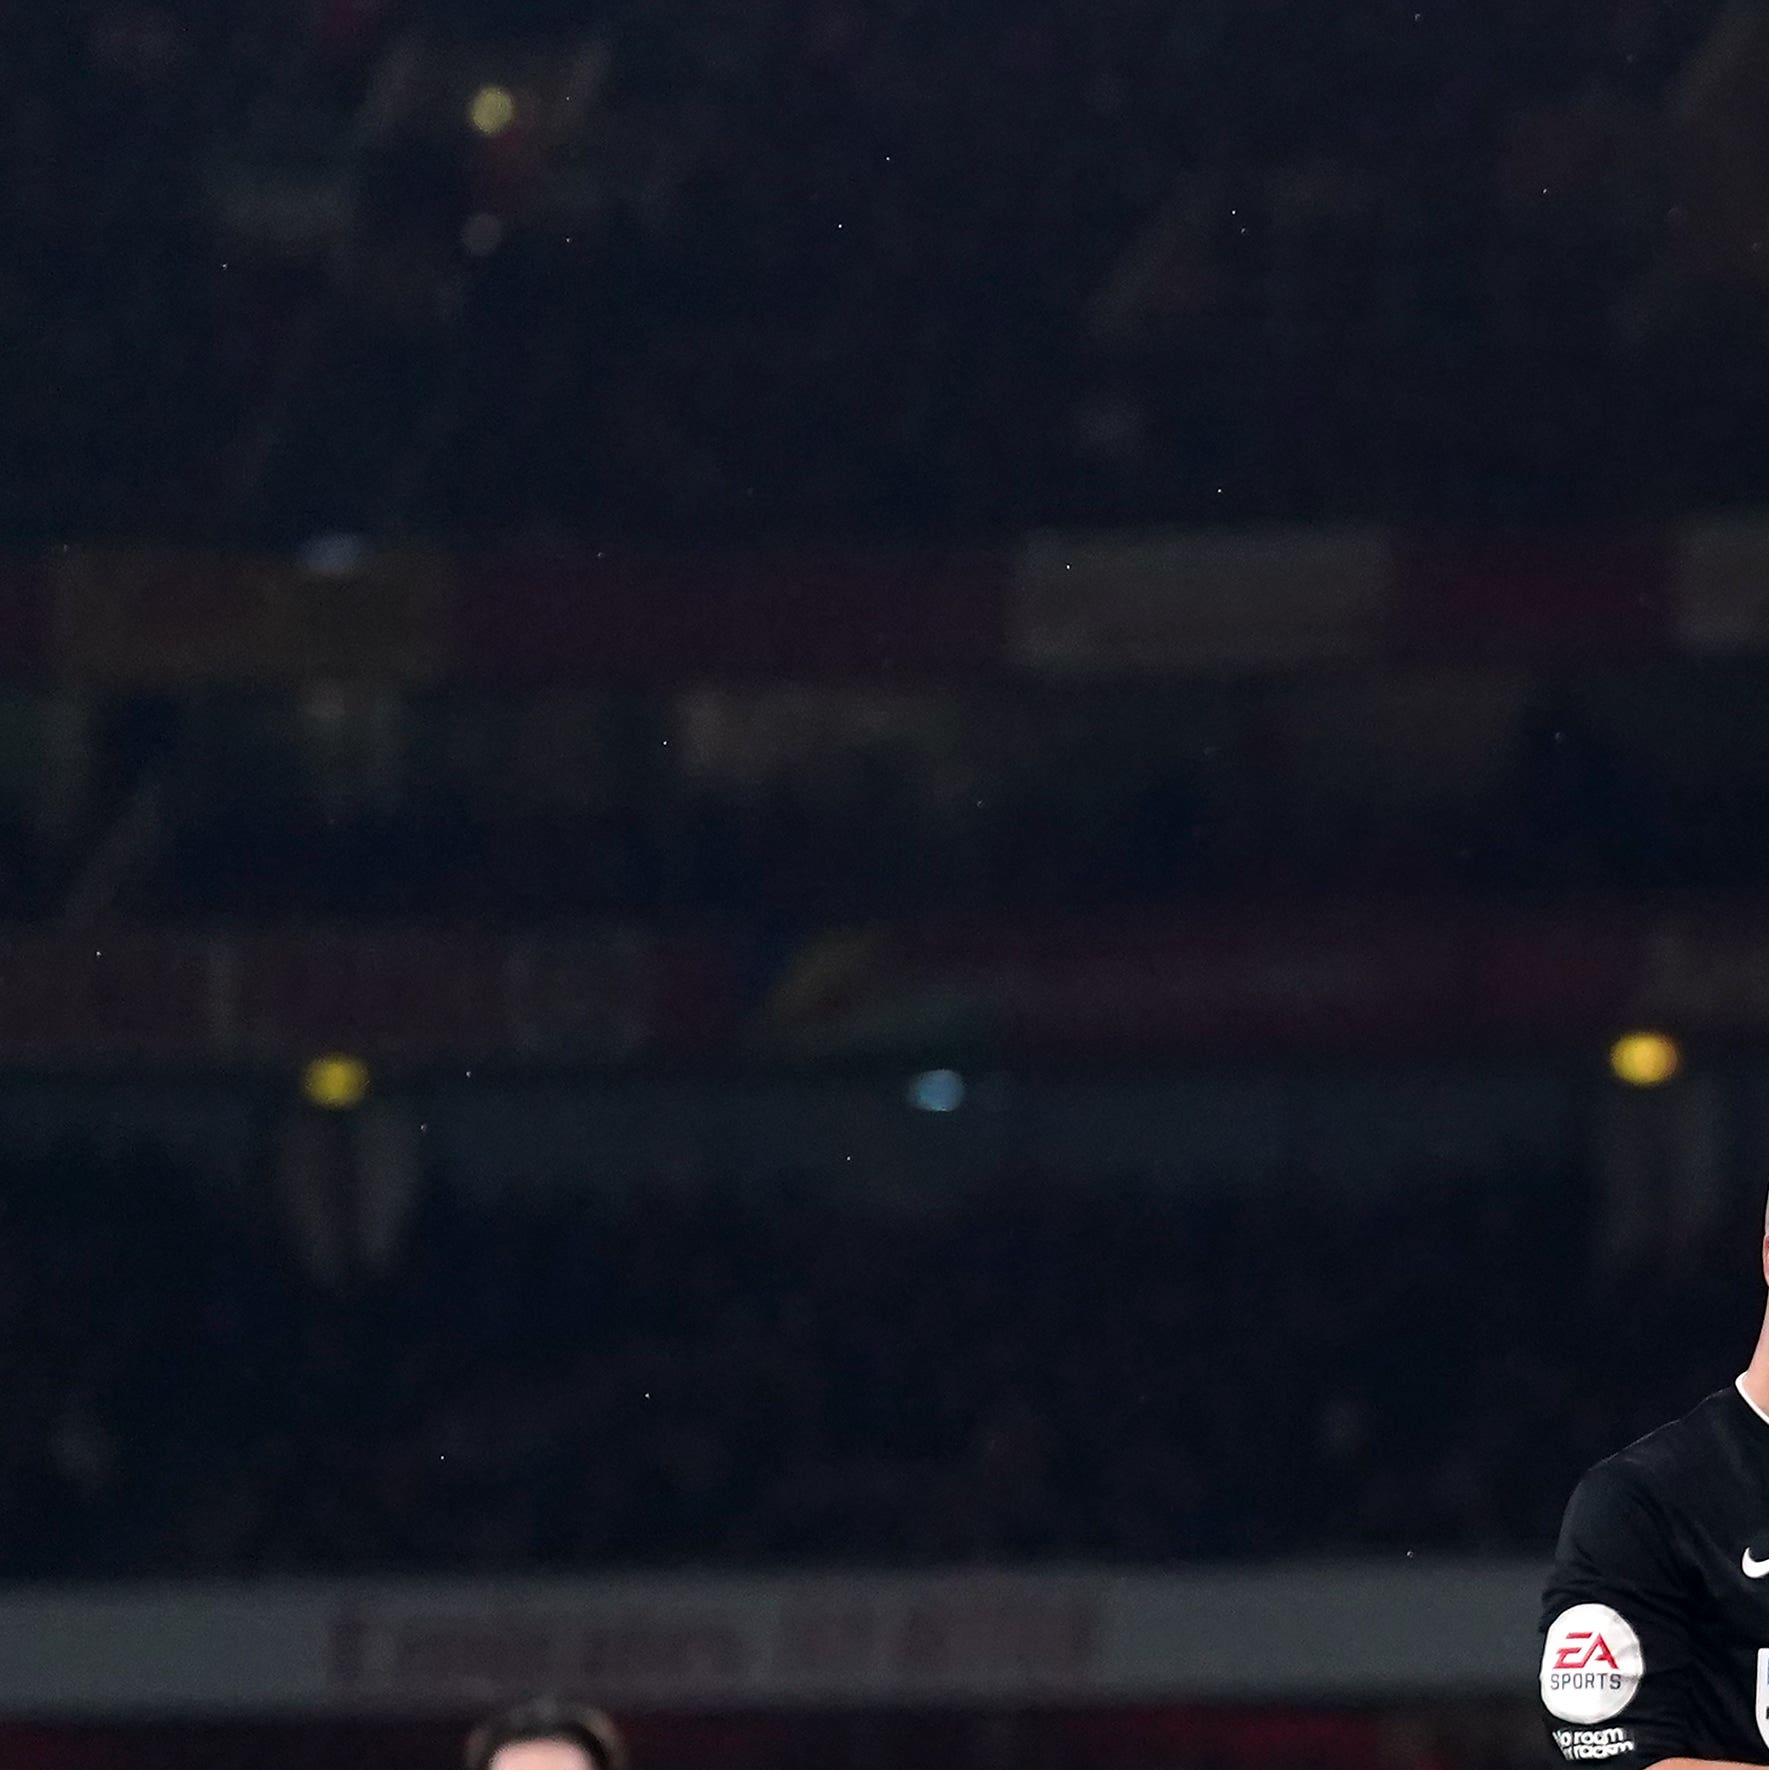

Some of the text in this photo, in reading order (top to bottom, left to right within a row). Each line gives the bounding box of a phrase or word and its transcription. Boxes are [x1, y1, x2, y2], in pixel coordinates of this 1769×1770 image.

[1553, 1631, 1620, 1669] EA
[1550, 1672, 1622, 1690] SPORTS
[1574, 1728, 1623, 1745] room
